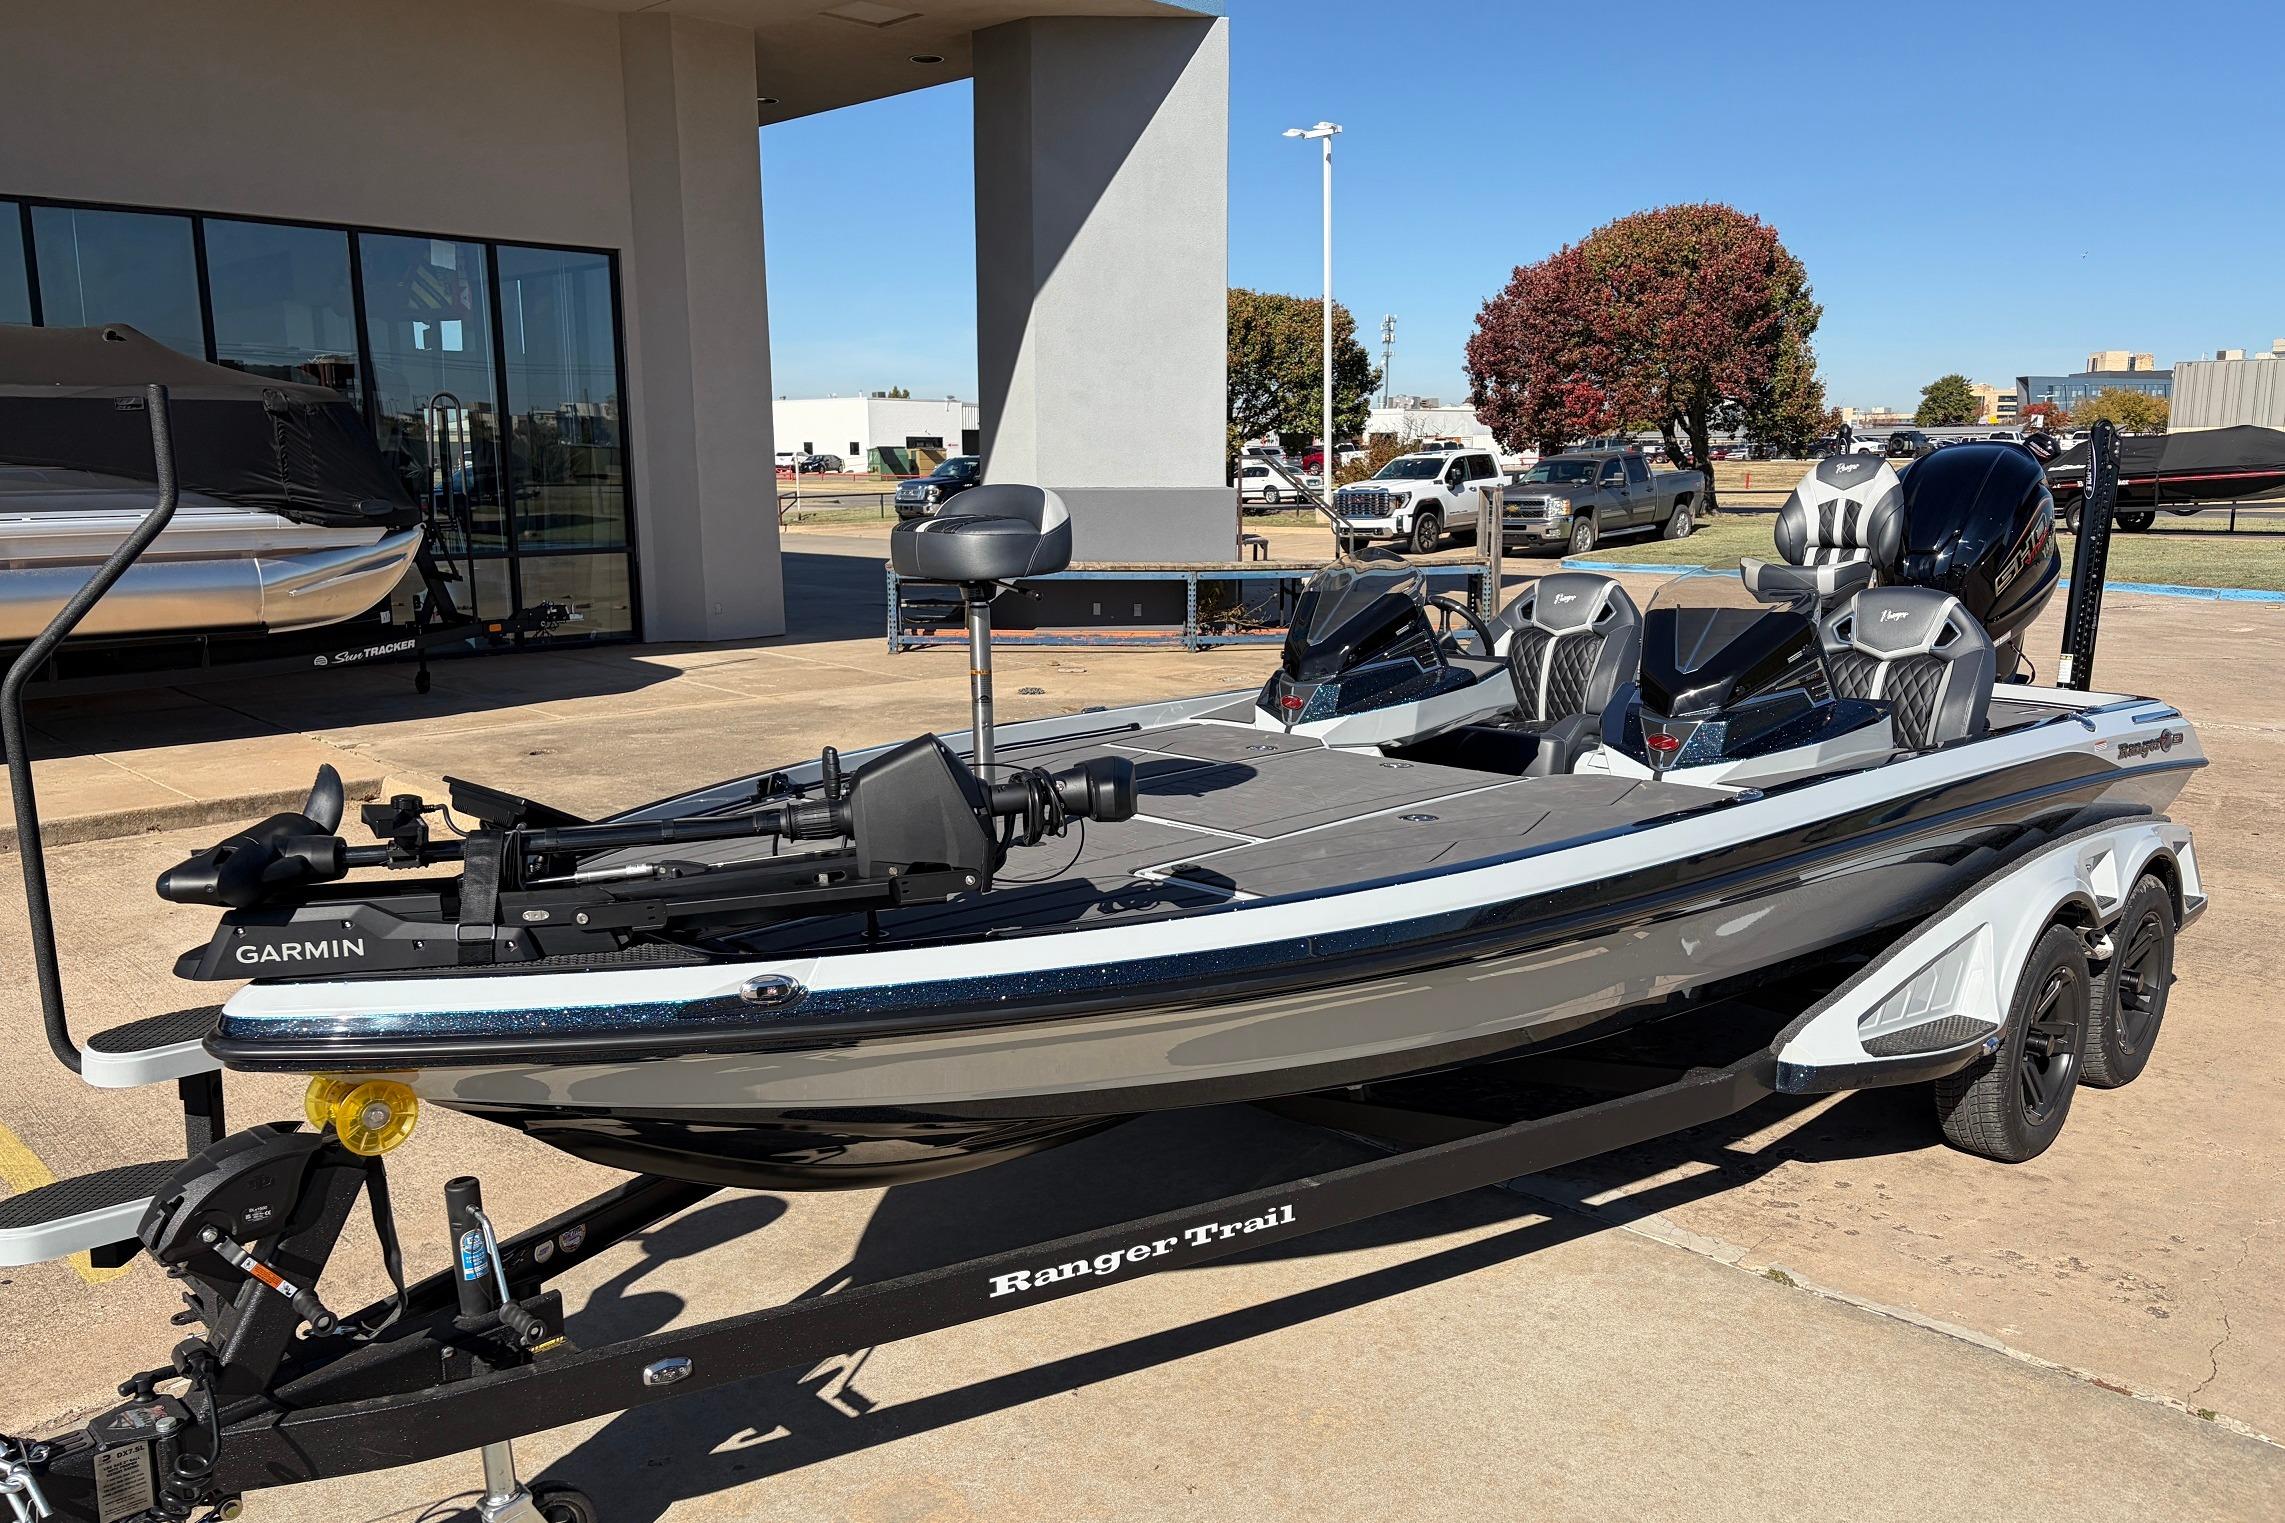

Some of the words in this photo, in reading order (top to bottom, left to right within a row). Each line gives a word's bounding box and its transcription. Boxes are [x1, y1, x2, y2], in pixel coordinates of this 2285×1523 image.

[331, 651, 364, 664] Sun
[363, 639, 416, 658] TRACKER
[235, 938, 365, 964] GARMIN
[989, 1235, 1179, 1298] Ranger
[1184, 1204, 1296, 1247] Trail
